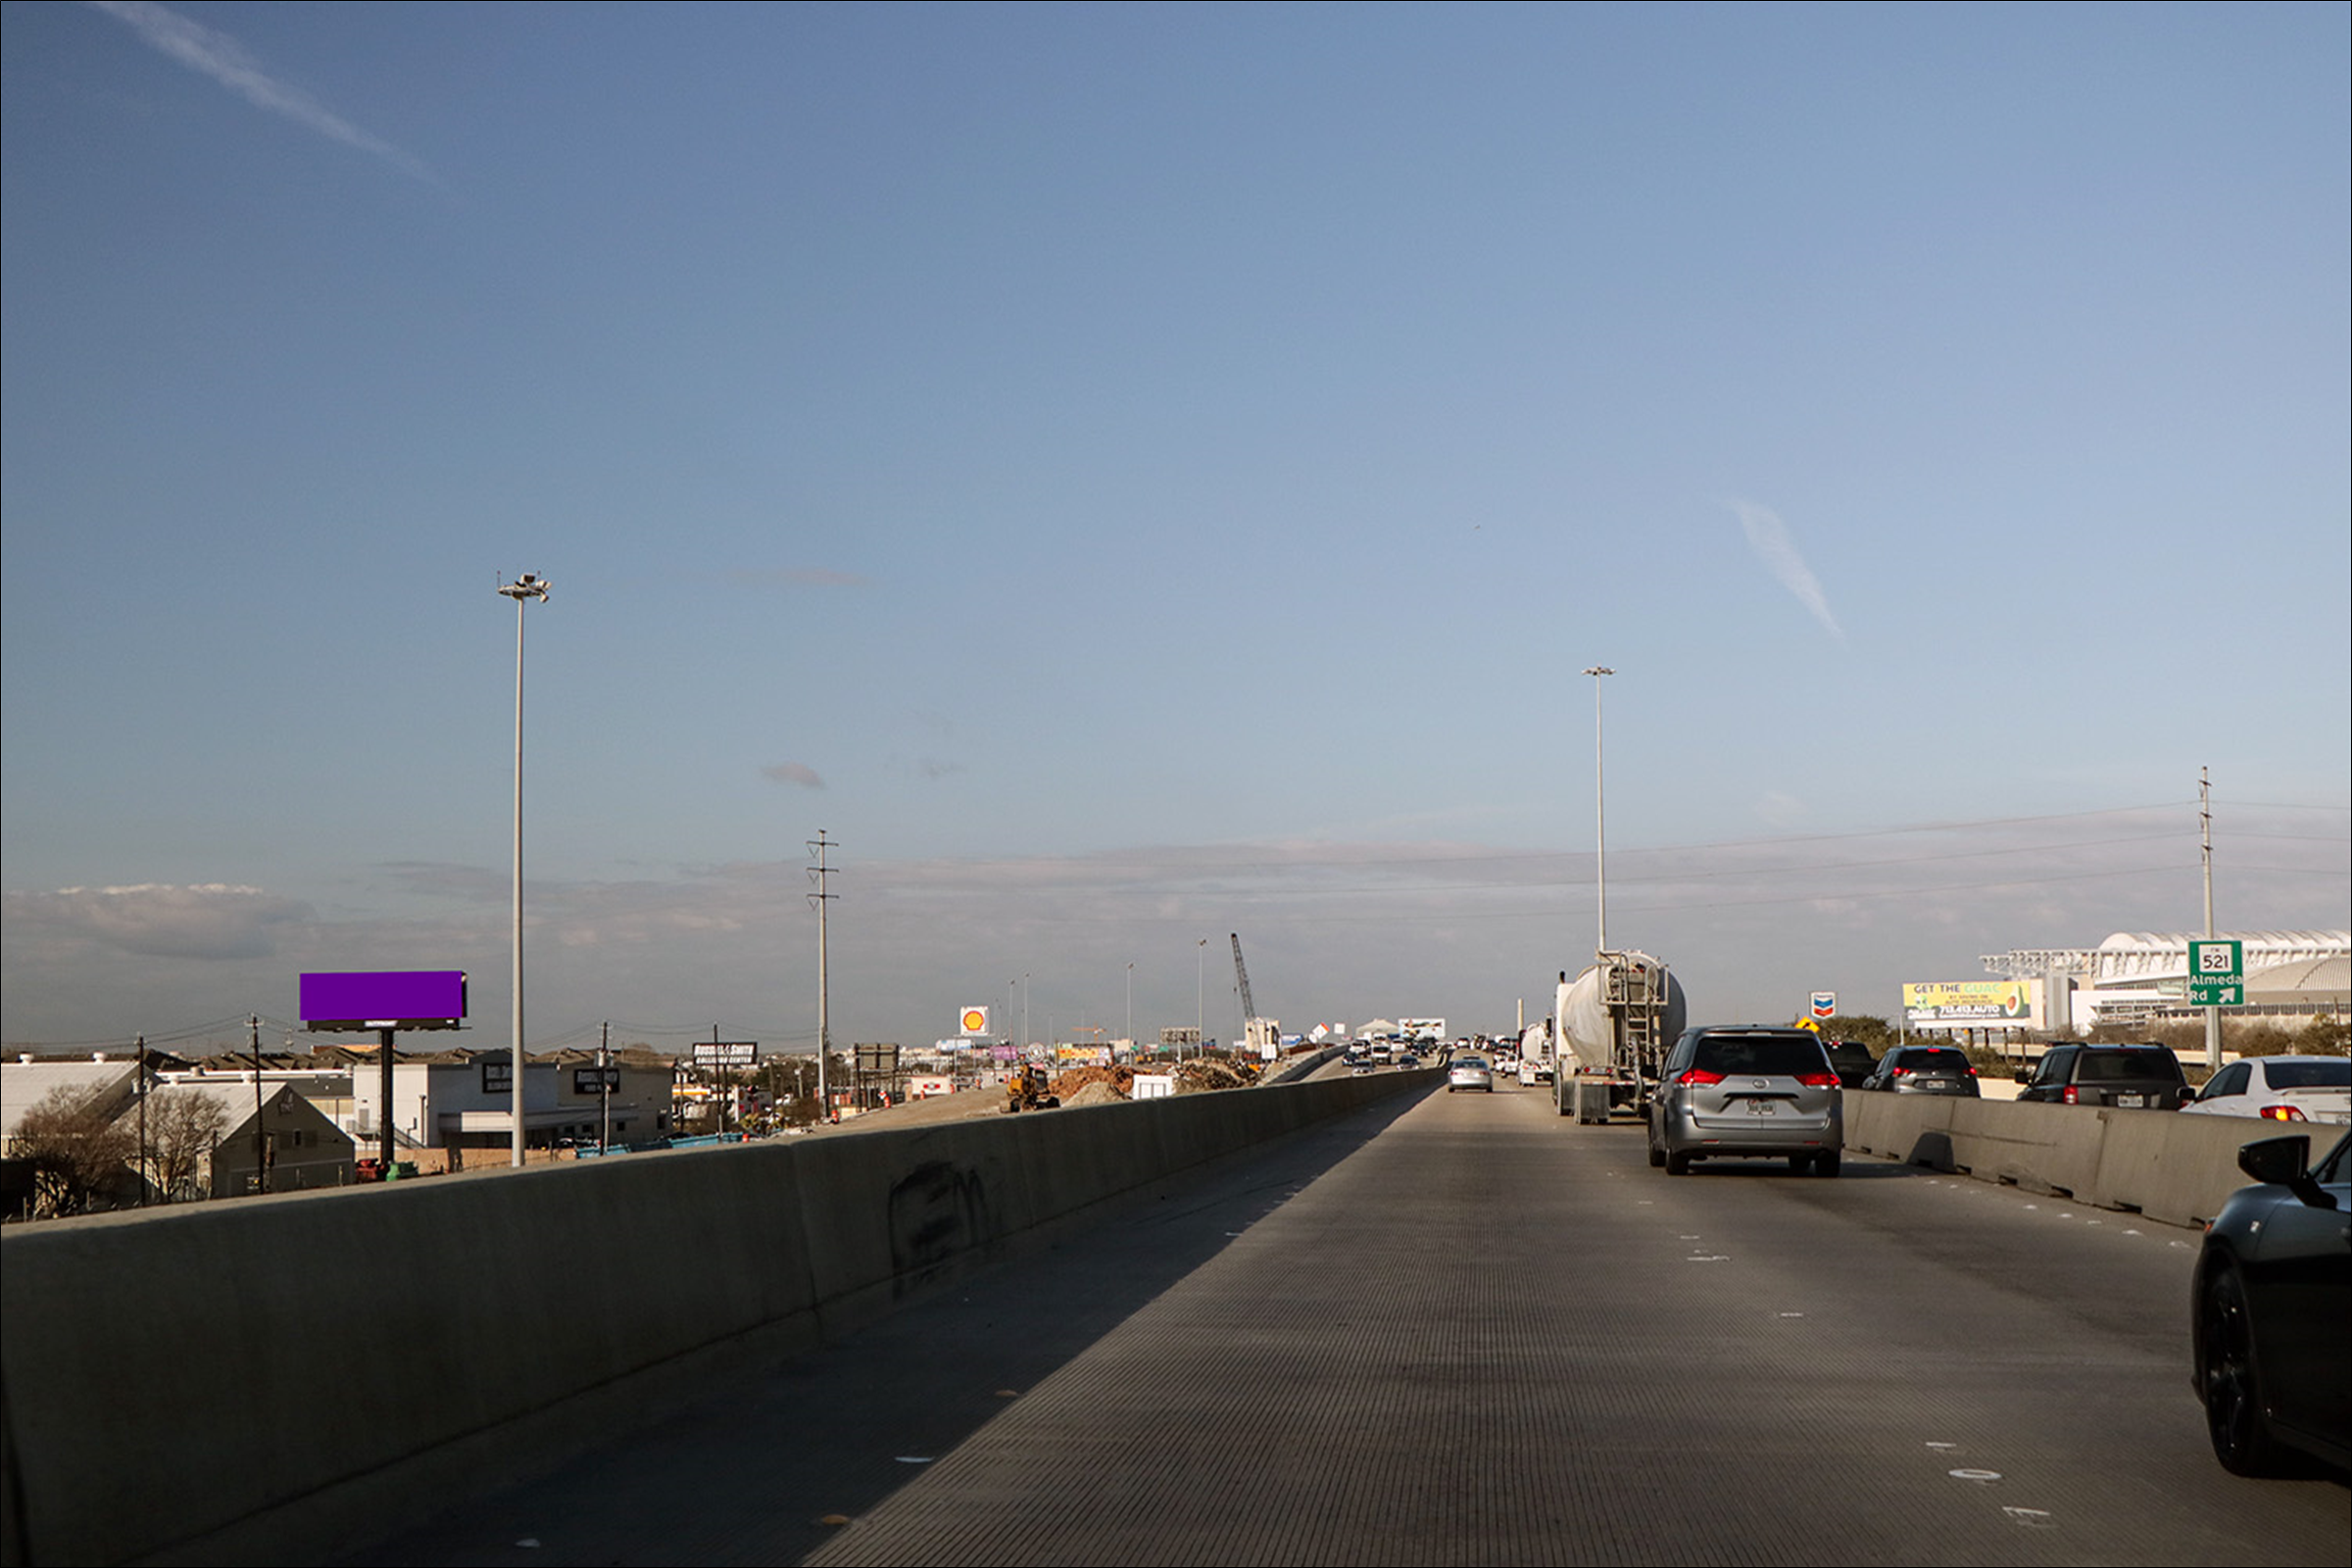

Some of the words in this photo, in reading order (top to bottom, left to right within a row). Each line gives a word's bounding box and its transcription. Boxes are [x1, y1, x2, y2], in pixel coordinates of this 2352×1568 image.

[2203, 955, 2229, 969] 521
[2189, 974, 2243, 985] Almeda
[1914, 984, 1935, 994] GET
[1940, 984, 1960, 993] THE
[1964, 983, 2001, 993] GUAC
[2189, 990, 2208, 1001] Rd
